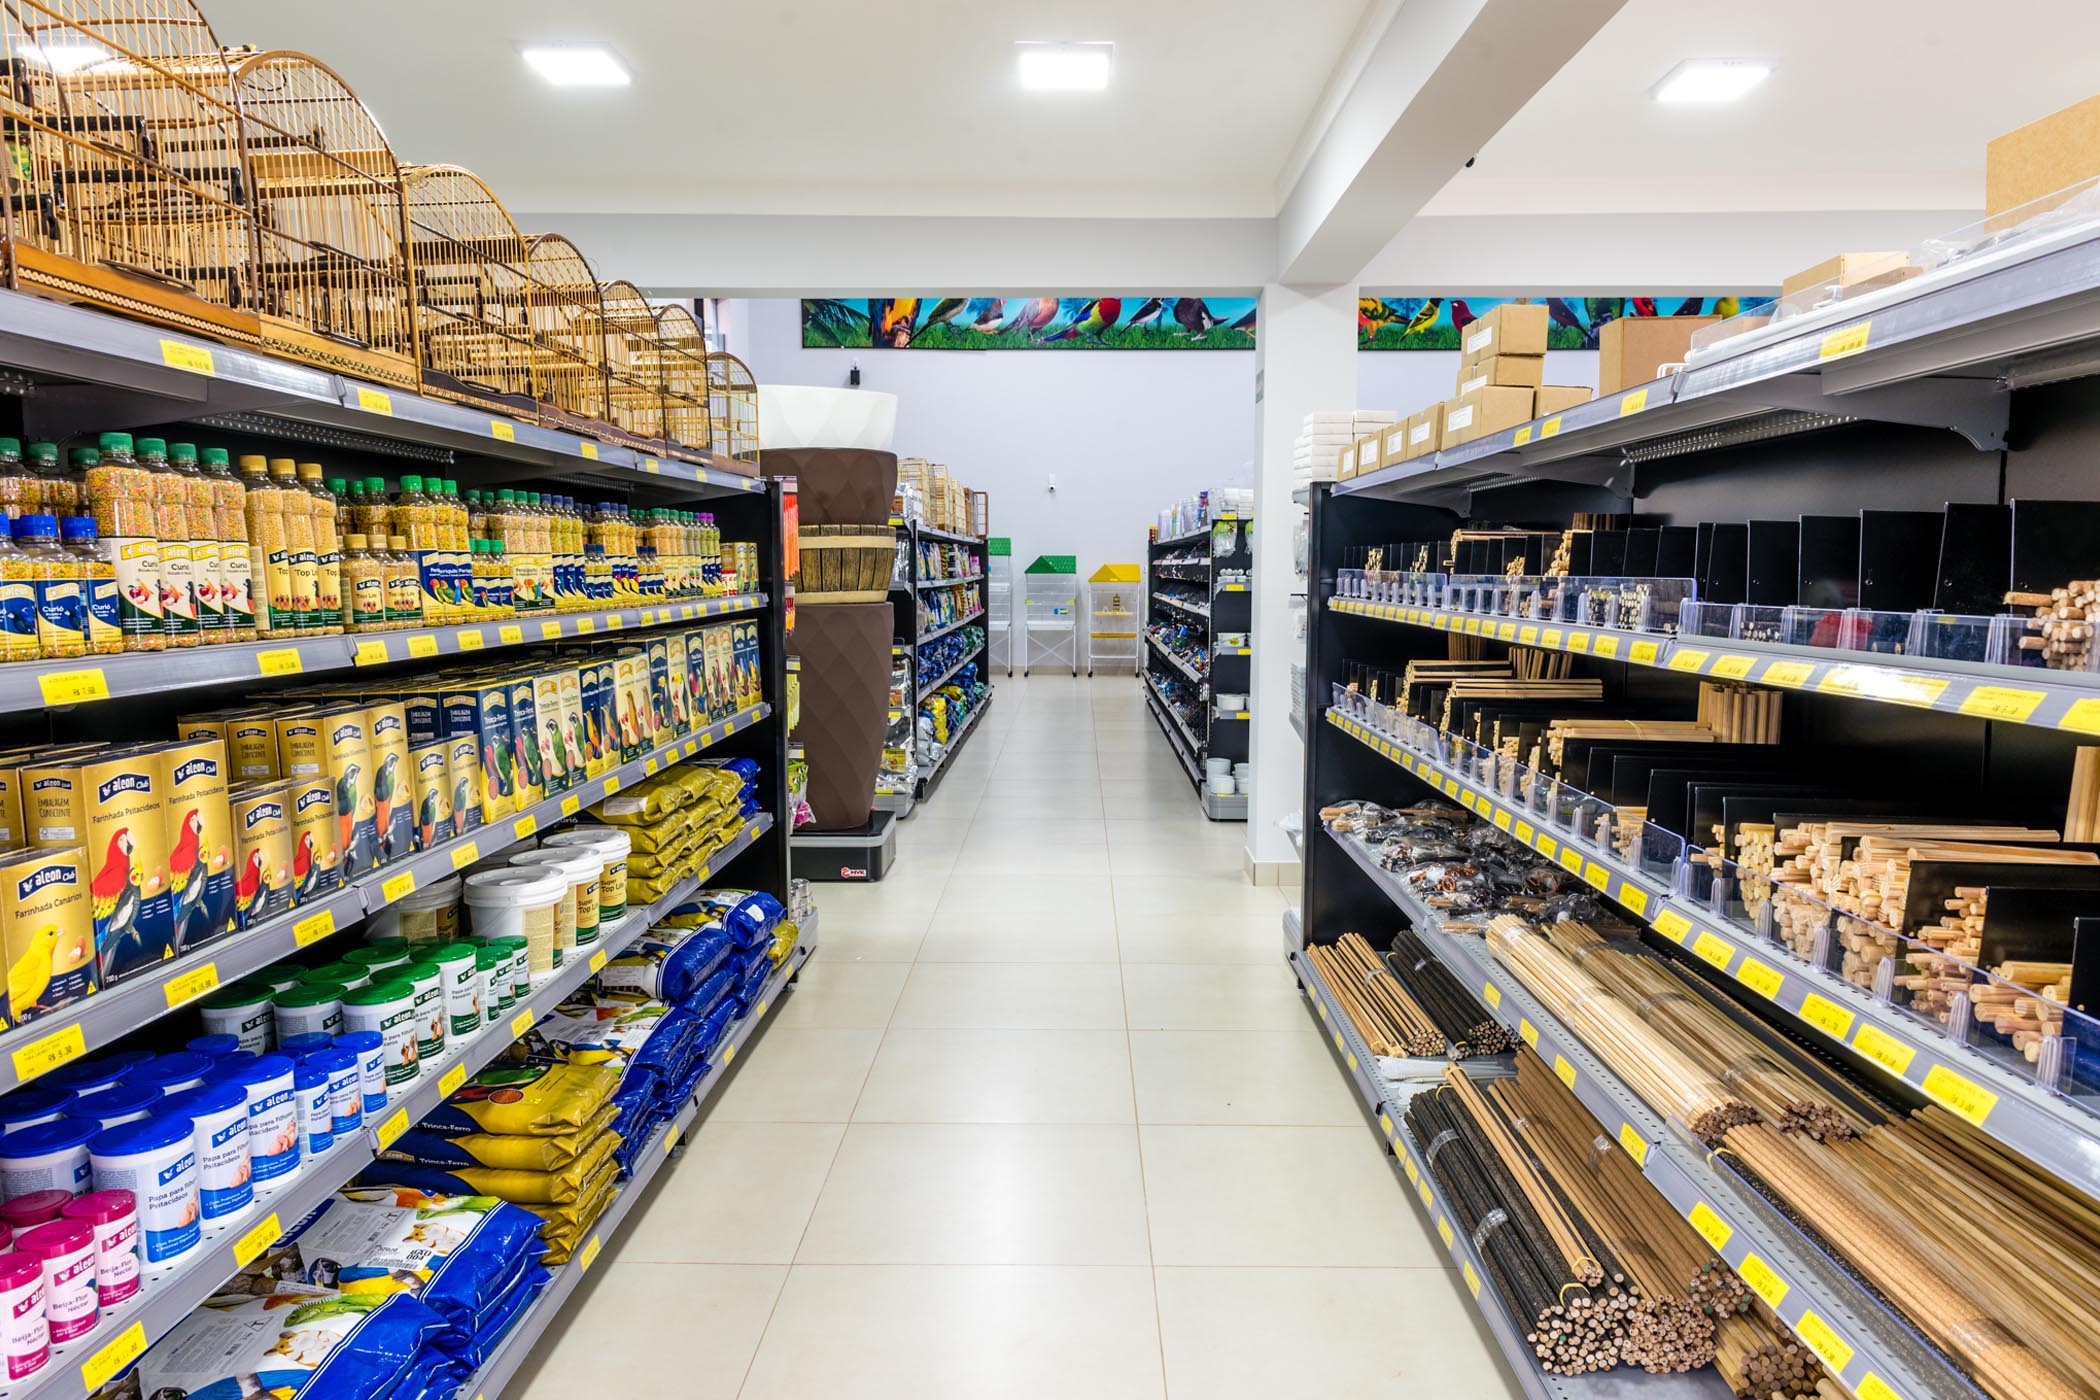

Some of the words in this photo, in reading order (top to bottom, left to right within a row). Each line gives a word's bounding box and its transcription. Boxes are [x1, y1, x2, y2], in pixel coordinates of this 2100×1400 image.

[35, 868, 61, 886] alcon
[62, 871, 76, 882] Club
[15, 902, 53, 919] Farinhada
